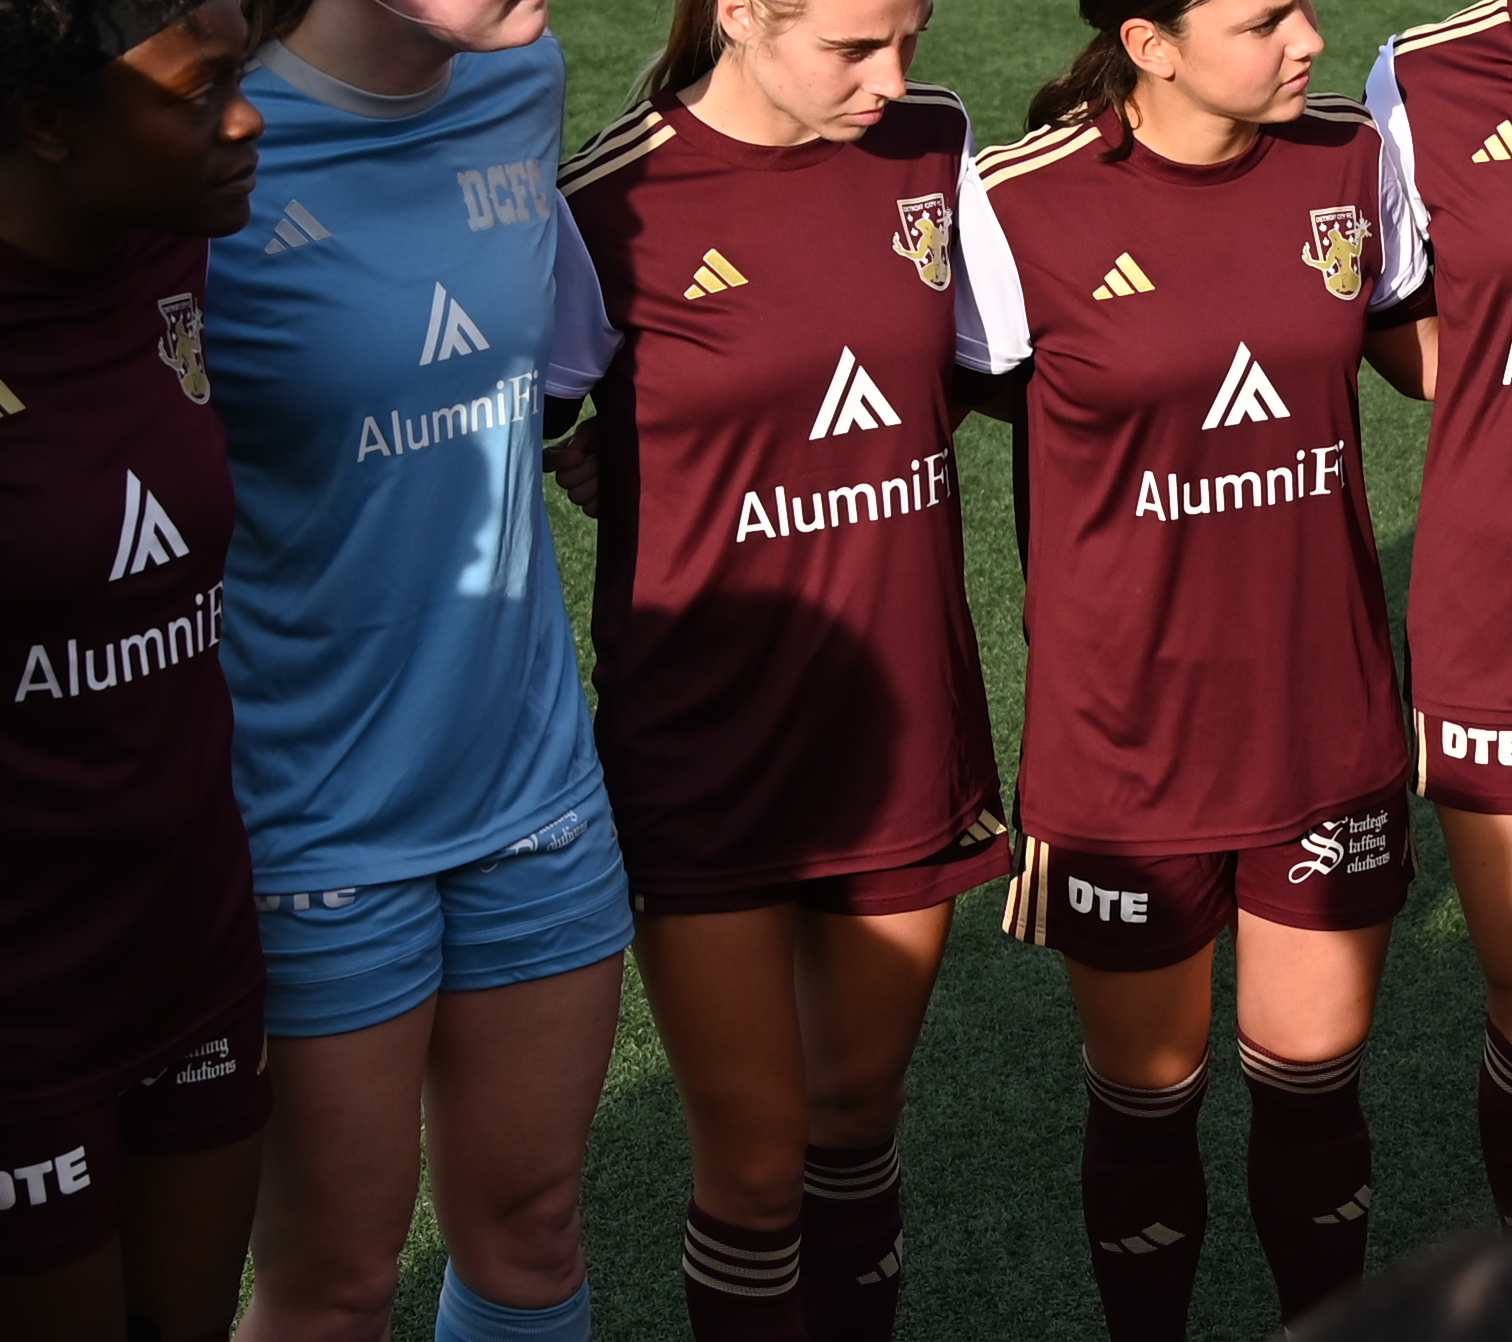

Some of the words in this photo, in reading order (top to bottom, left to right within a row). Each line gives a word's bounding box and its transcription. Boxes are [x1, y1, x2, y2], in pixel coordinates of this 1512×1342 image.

[456, 159, 553, 232] DCFC
[356, 369, 540, 463] AlumniFi
[736, 448, 952, 543] AlumniFi
[1135, 440, 1346, 521] AlumniFi
[14, 580, 225, 703] AlumniF
[1068, 876, 1149, 924] DTE
